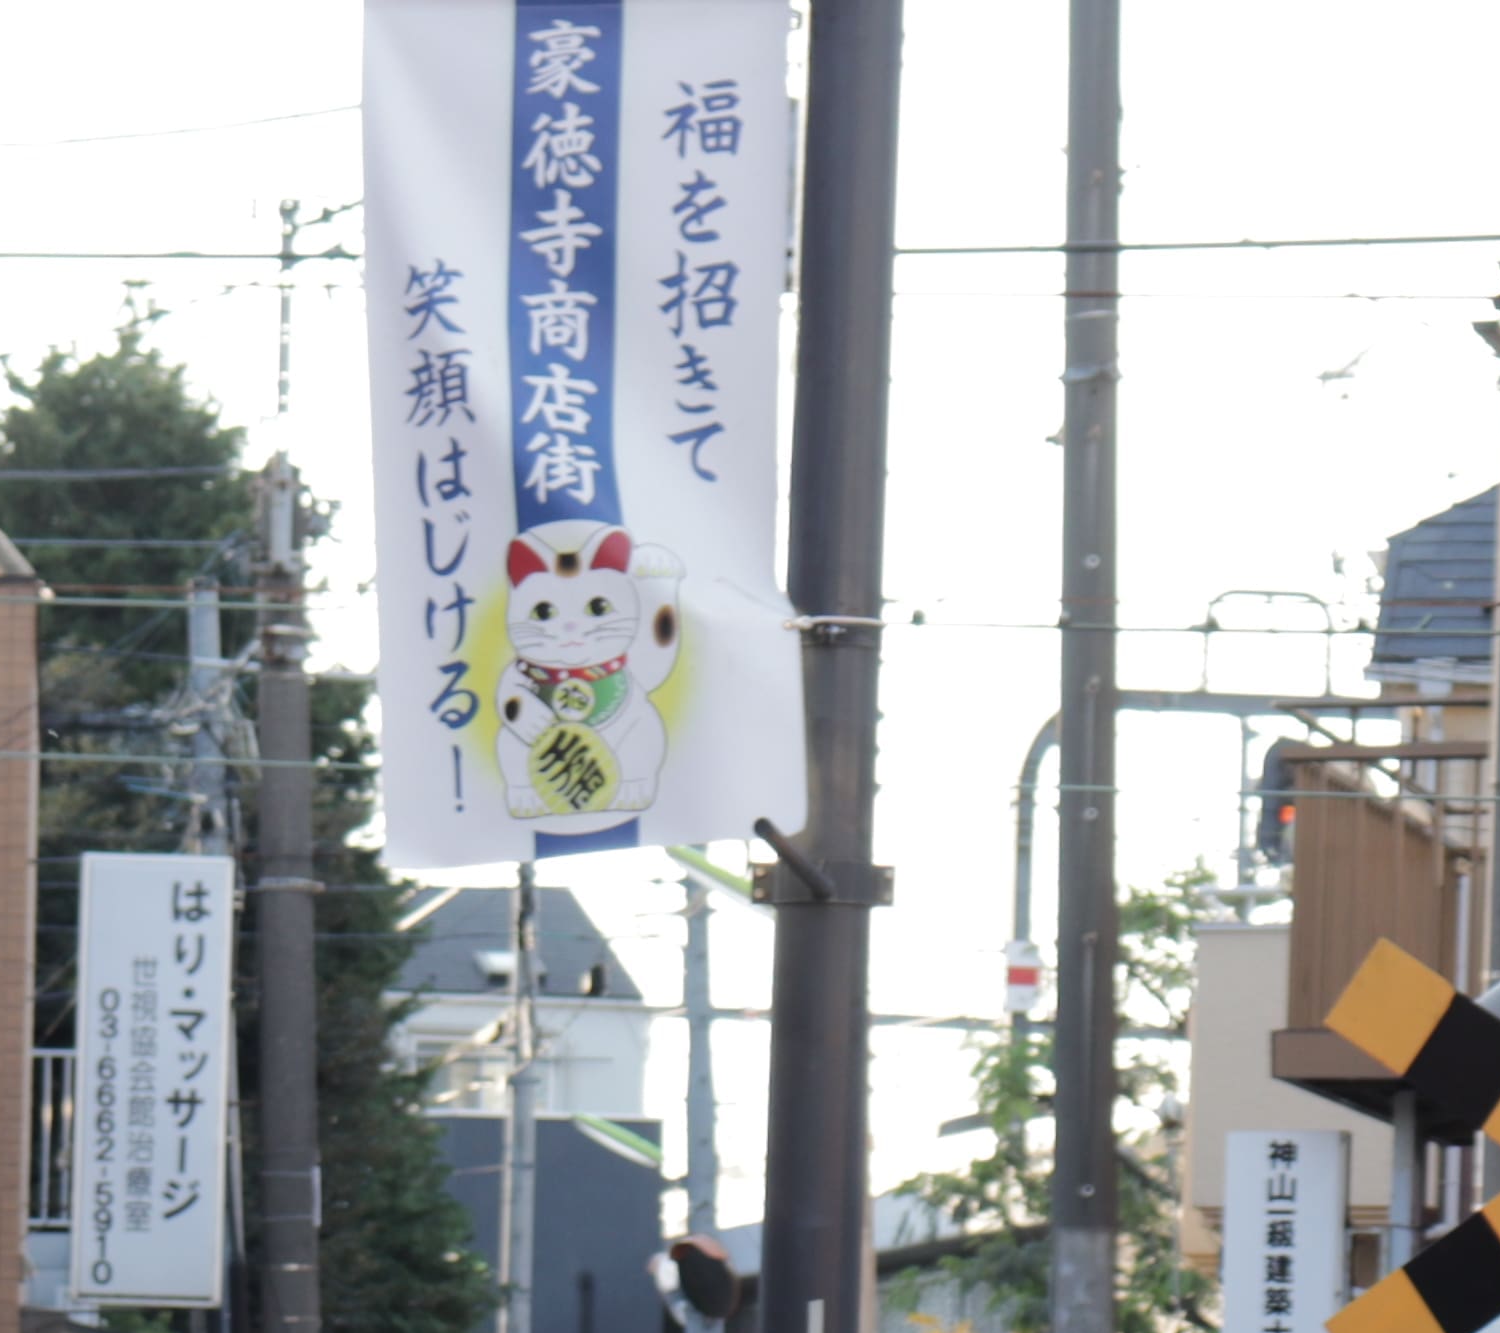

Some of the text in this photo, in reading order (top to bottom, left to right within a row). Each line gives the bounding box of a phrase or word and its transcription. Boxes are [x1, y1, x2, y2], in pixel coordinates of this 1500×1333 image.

[519, 20, 604, 506] 豪徳寺商店街
[658, 79, 743, 484] 福を招きて
[91, 988, 121, 1285] 03-6662-5910
[164, 880, 210, 1219] はり・マッサージ
